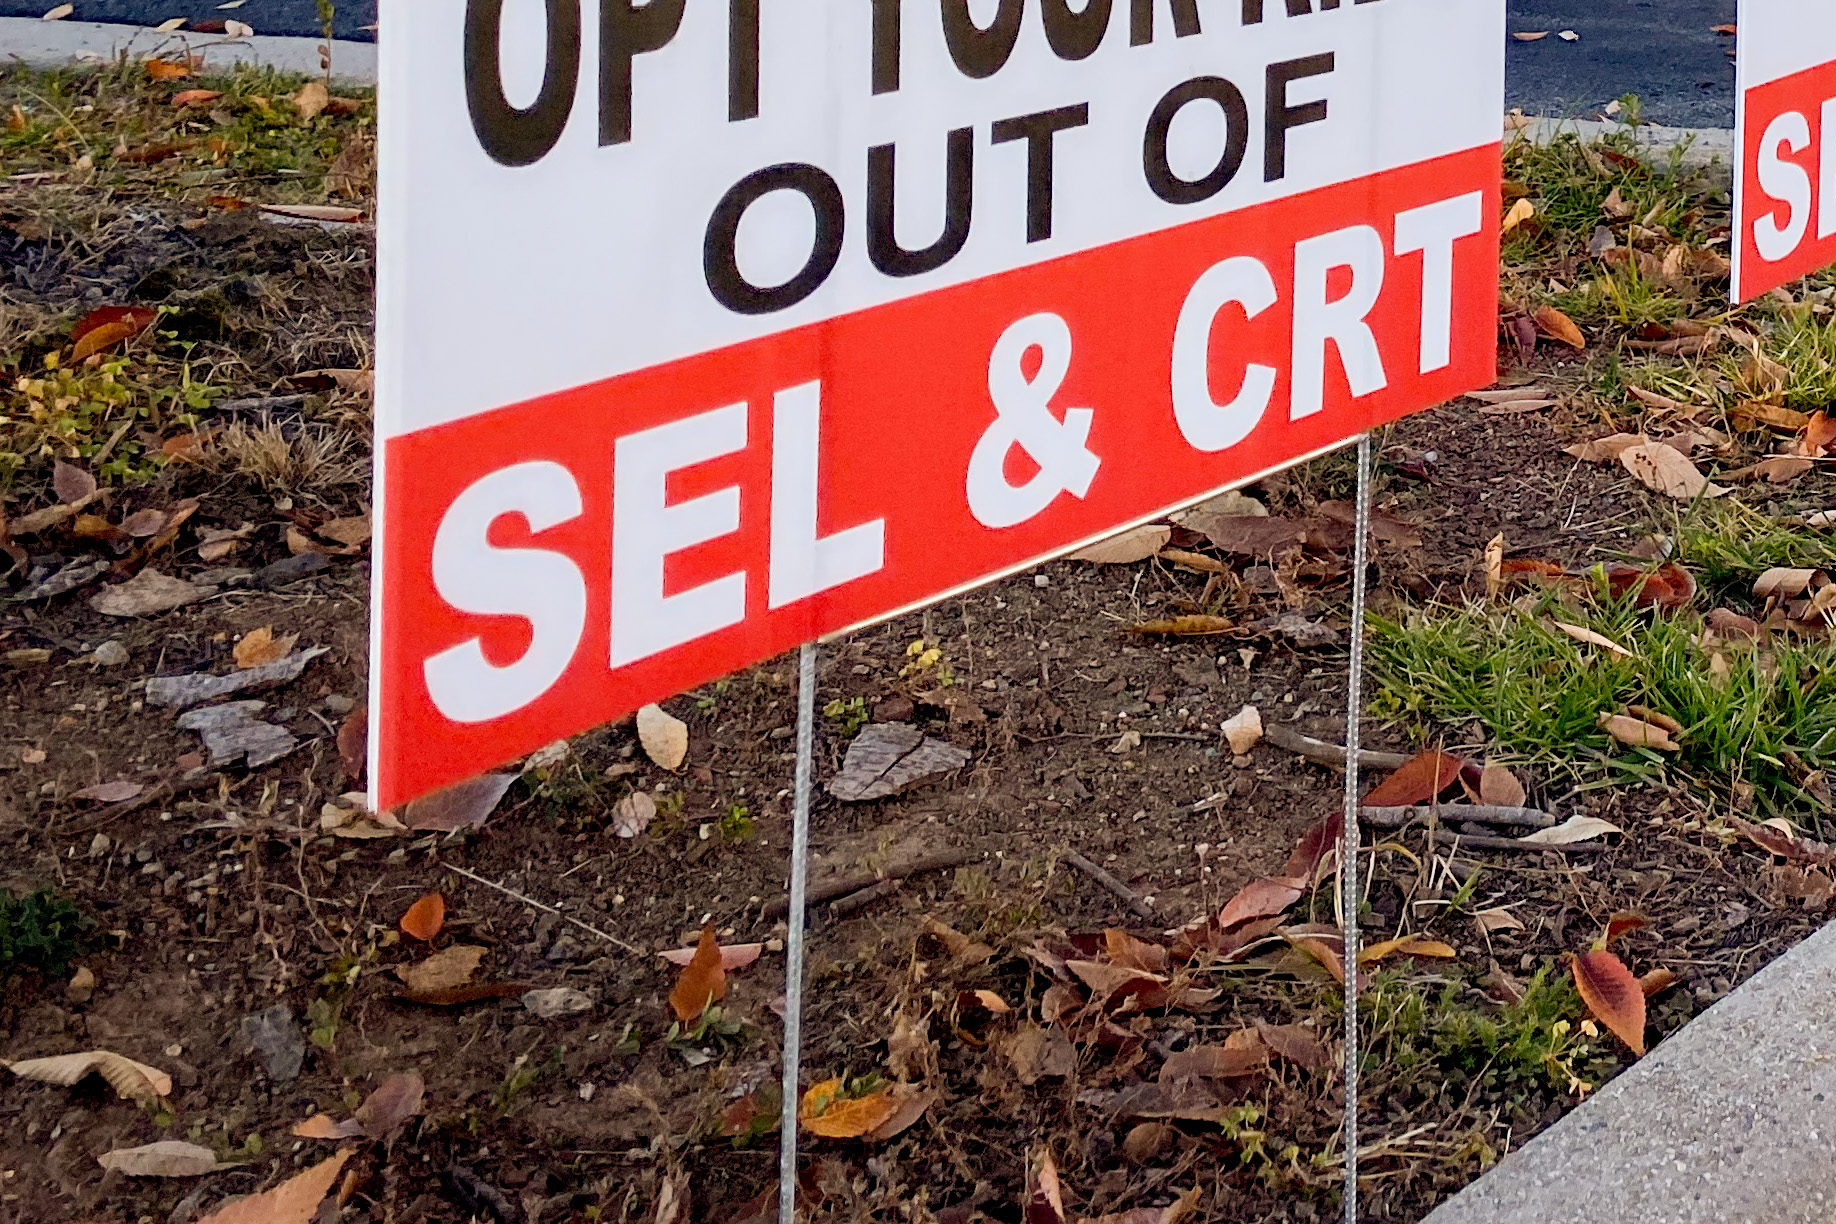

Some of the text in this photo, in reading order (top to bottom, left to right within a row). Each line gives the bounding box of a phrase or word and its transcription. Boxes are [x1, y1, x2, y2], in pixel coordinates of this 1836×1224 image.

[702, 52, 1337, 316] OUT OF
[424, 190, 1484, 725] SEL & CRT
